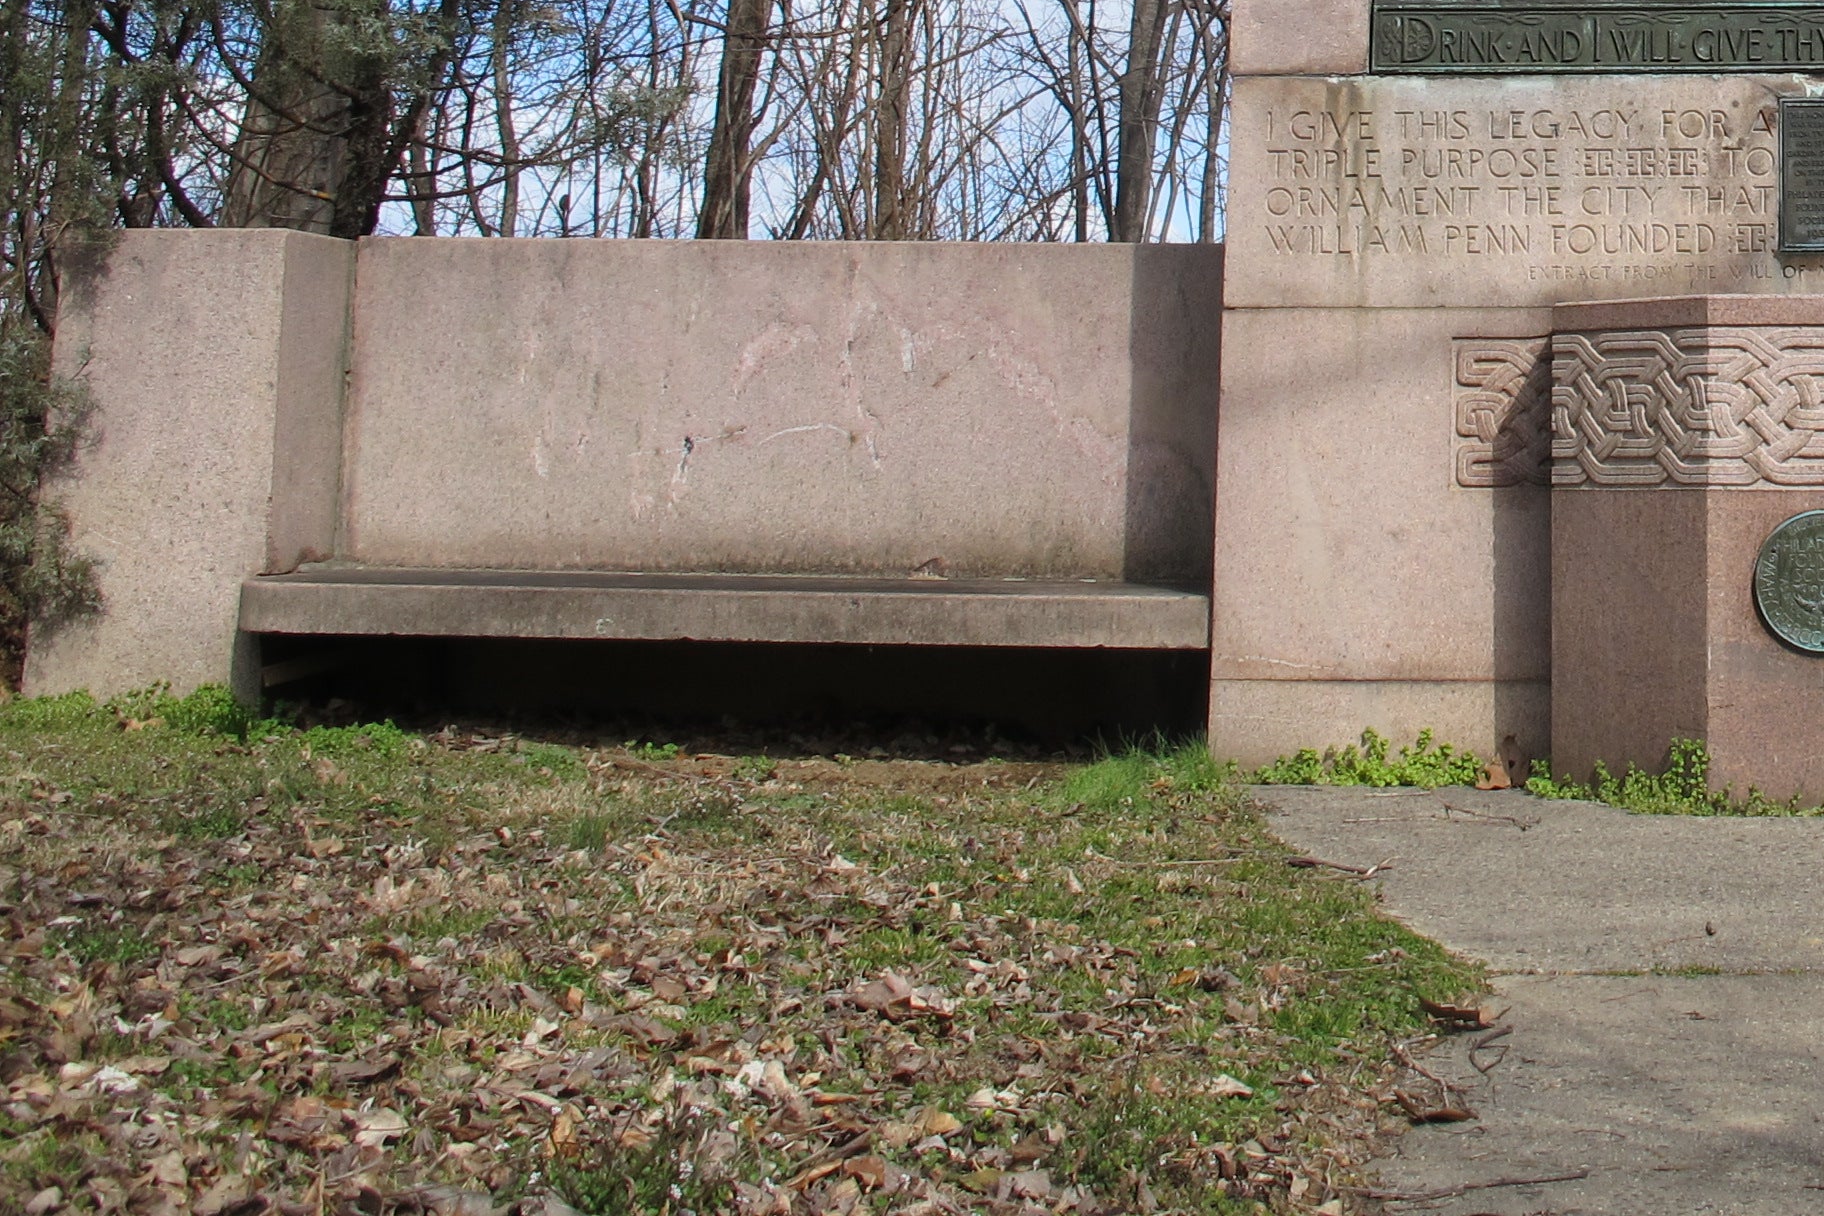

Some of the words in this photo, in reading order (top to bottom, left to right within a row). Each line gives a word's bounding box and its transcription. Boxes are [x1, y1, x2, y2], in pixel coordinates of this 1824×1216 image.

[1516, 29, 1584, 63] AND
[1593, 17, 1601, 63] I
[1610, 29, 1683, 63] WILL
[1692, 28, 1761, 61] GIVE
[1267, 111, 1274, 141] I
[1290, 111, 1374, 140] GIVE
[1394, 111, 1470, 140] THIS
[1488, 110, 1637, 140] LEGACY
[1660, 110, 1728, 139] FOR
[1748, 109, 1774, 139] A
[1267, 148, 1382, 179] TRIPLE
[1402, 148, 1559, 178] PURPOSE
[1722, 146, 1775, 177] TO
[1266, 187, 1479, 217] ORNAMENT
[1500, 187, 1564, 216] THE
[1581, 186, 1664, 215] CITY
[1681, 185, 1775, 215] THAT
[1264, 224, 1429, 255] WILLIAM
[1445, 224, 1531, 254] PENN
[1551, 223, 1716, 254] FOUNDED
[1529, 265, 1610, 280] EXTRACT
[1622, 264, 1674, 280] FROM
[1685, 264, 1716, 280] THE
[1728, 264, 1772, 280] WILL
[1782, 264, 1806, 280] OF
